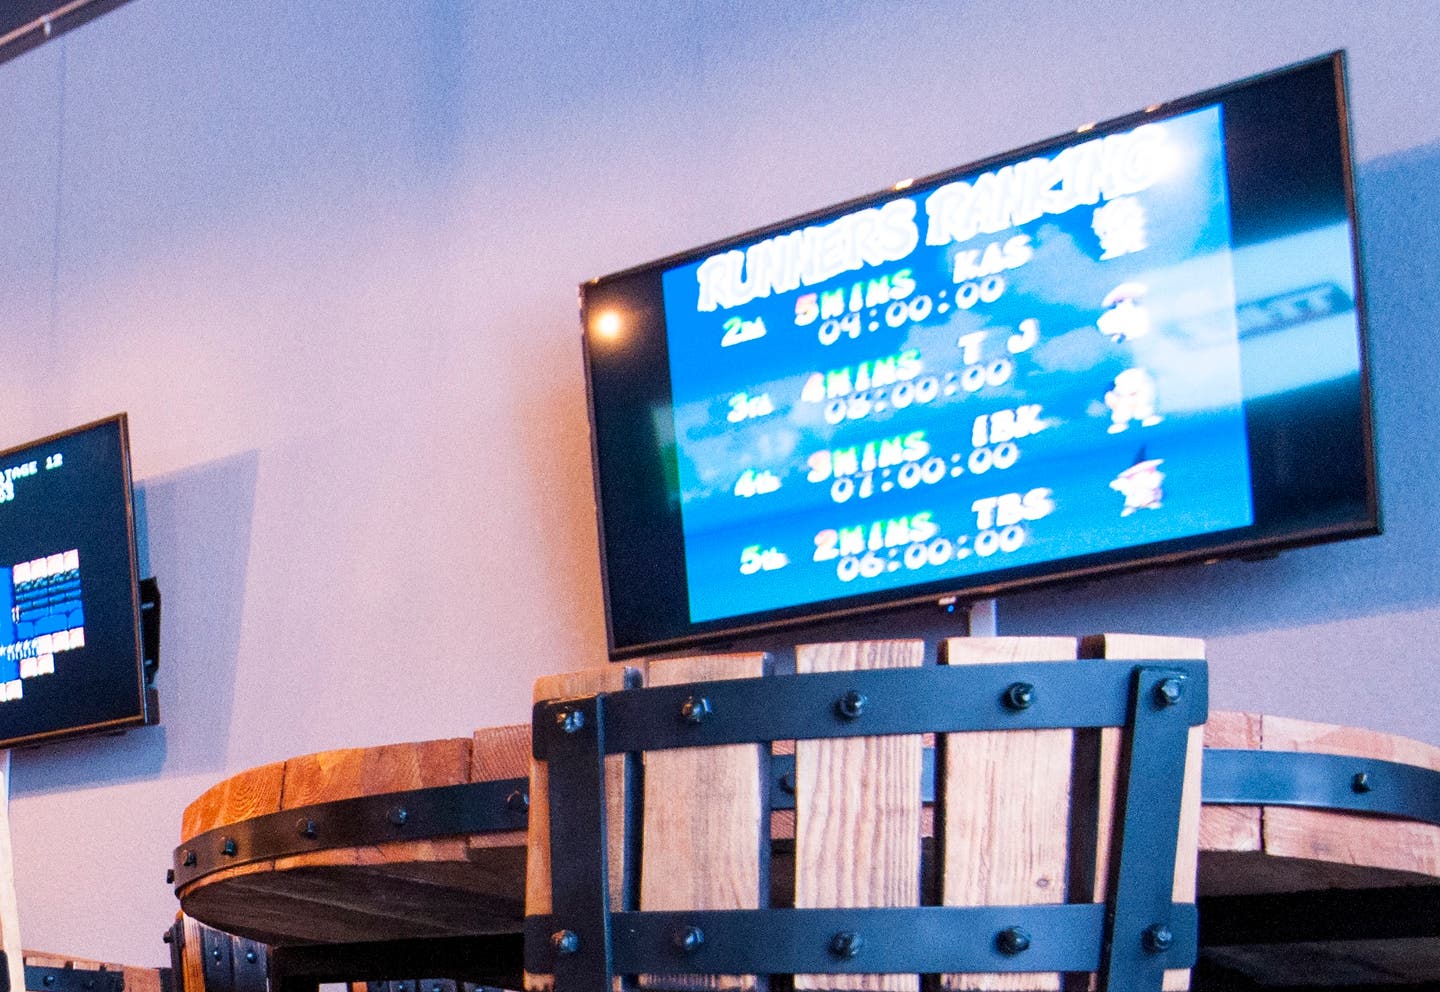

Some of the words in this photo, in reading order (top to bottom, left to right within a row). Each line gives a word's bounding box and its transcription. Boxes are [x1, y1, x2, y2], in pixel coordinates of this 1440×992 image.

[697, 198, 919, 312] RUNNERS
[926, 123, 1164, 246] RANKING
[951, 234, 1035, 284] KAS
[971, 487, 1055, 530] TBS
[836, 525, 1027, 582] 06:00:00
